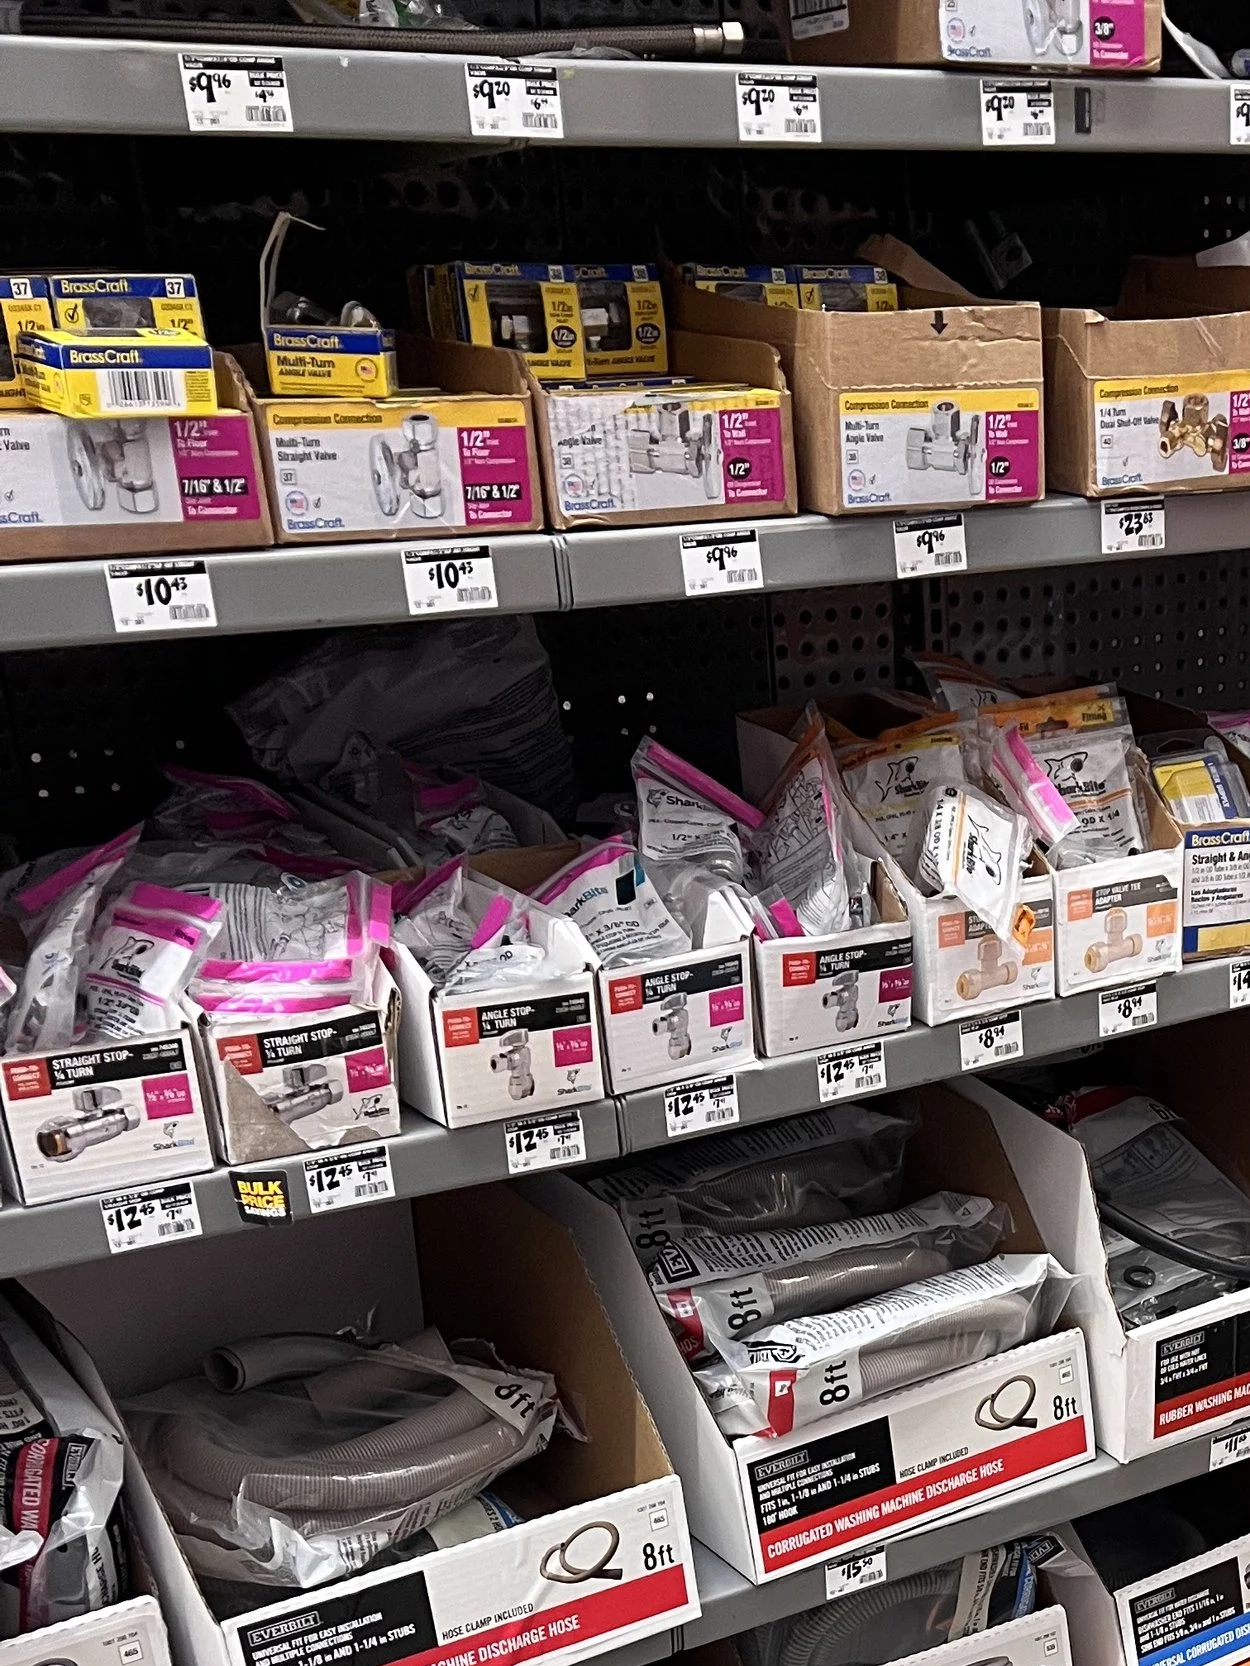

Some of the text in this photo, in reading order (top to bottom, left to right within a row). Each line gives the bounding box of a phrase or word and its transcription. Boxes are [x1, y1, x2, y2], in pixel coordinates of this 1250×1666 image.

[13, 282, 28, 298] 37
[61, 280, 182, 296] BrassCraft 37
[273, 332, 341, 350] BrassCraft
[70, 347, 140, 365] BrassCraft
[277, 356, 336, 370] Multi-Turn
[273, 414, 383, 428] Compression Connection
[175, 420, 208, 439] 1/2"
[276, 438, 321, 449] Multi-Turn
[846, 432, 884, 446] Angle Valve
[278, 450, 337, 464] Straight Valve
[213, 481, 223, 493] &
[287, 518, 345, 530] BrassCraft
[1191, 830, 1250, 847] BrassCraft
[1192, 852, 1227, 866] Straight
[1229, 851, 1236, 861] &
[646, 976, 670, 990] ANGLE
[657, 983, 677, 995] TURN
[482, 1008, 507, 1022] ANGLE
[495, 1017, 518, 1029] TURN
[264, 1033, 309, 1050] STRAIGHT
[276, 1044, 302, 1058] TURN
[52, 1053, 102, 1072] STRAIGHT
[67, 1066, 95, 1079] TURN
[237, 1180, 284, 1196] BULK
[241, 1194, 285, 1209] PRICE
[244, 1206, 287, 1218] SAVINGS
[819, 1358, 851, 1407] 8ft
[1053, 1395, 1078, 1421] 8ft
[1159, 1403, 1194, 1427] RUBBER
[1195, 1389, 1233, 1413] WASHING
[768, 1458, 1005, 1560] CORRUGATED WASHING MACHINE DISCHARGE HOSE
[643, 1542, 675, 1571] 8ft
[252, 1614, 316, 1644] EVERBILT
[442, 1602, 534, 1641] HOSE CLAMP INCLUDED
[252, 1612, 384, 1661] UNIVERSAL FIT FOR EASY INSTALLATION
[333, 1646, 352, 1661] AND
[355, 1637, 379, 1655] 1-1/4
[388, 1623, 416, 1641] STUBS
[478, 1628, 547, 1663] DISCHARGE
[548, 1614, 581, 1637] HOSE
[272, 1648, 305, 1666] MULTIPLE
[305, 1632, 354, 1654] CONNECTIONS
[1186, 1630, 1235, 1661] CORRUGATED
